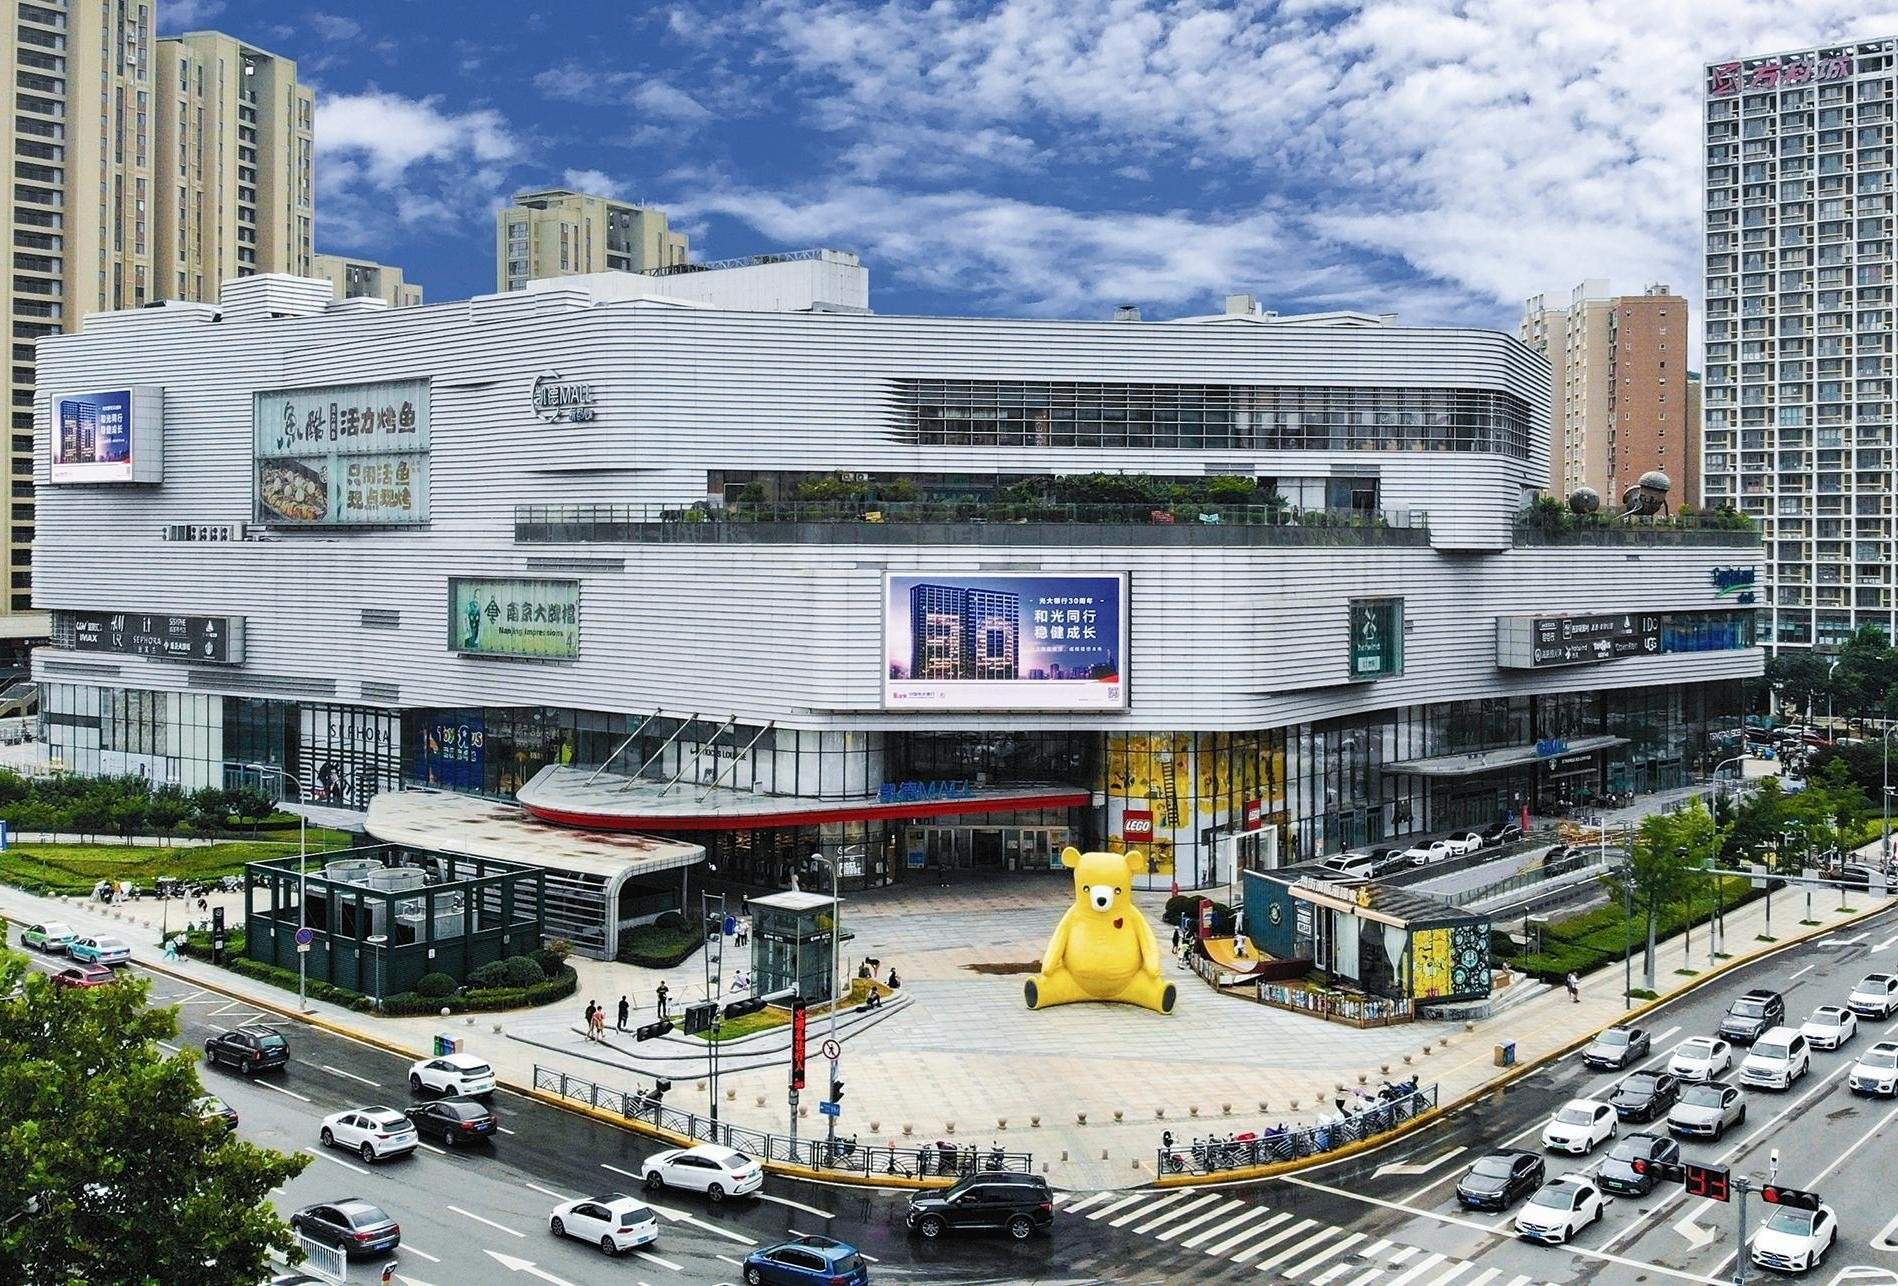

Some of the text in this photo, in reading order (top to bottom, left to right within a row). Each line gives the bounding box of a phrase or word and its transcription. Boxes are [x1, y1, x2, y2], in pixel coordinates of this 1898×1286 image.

[1034, 609, 1097, 624] 和光同行
[80, 633, 98, 643] IMAX
[1034, 625, 1097, 640] 稳健成长
[132, 635, 162, 645] SEPHORA
[1644, 637, 1658, 652] UGG
[1126, 821, 1150, 832] LEGO
